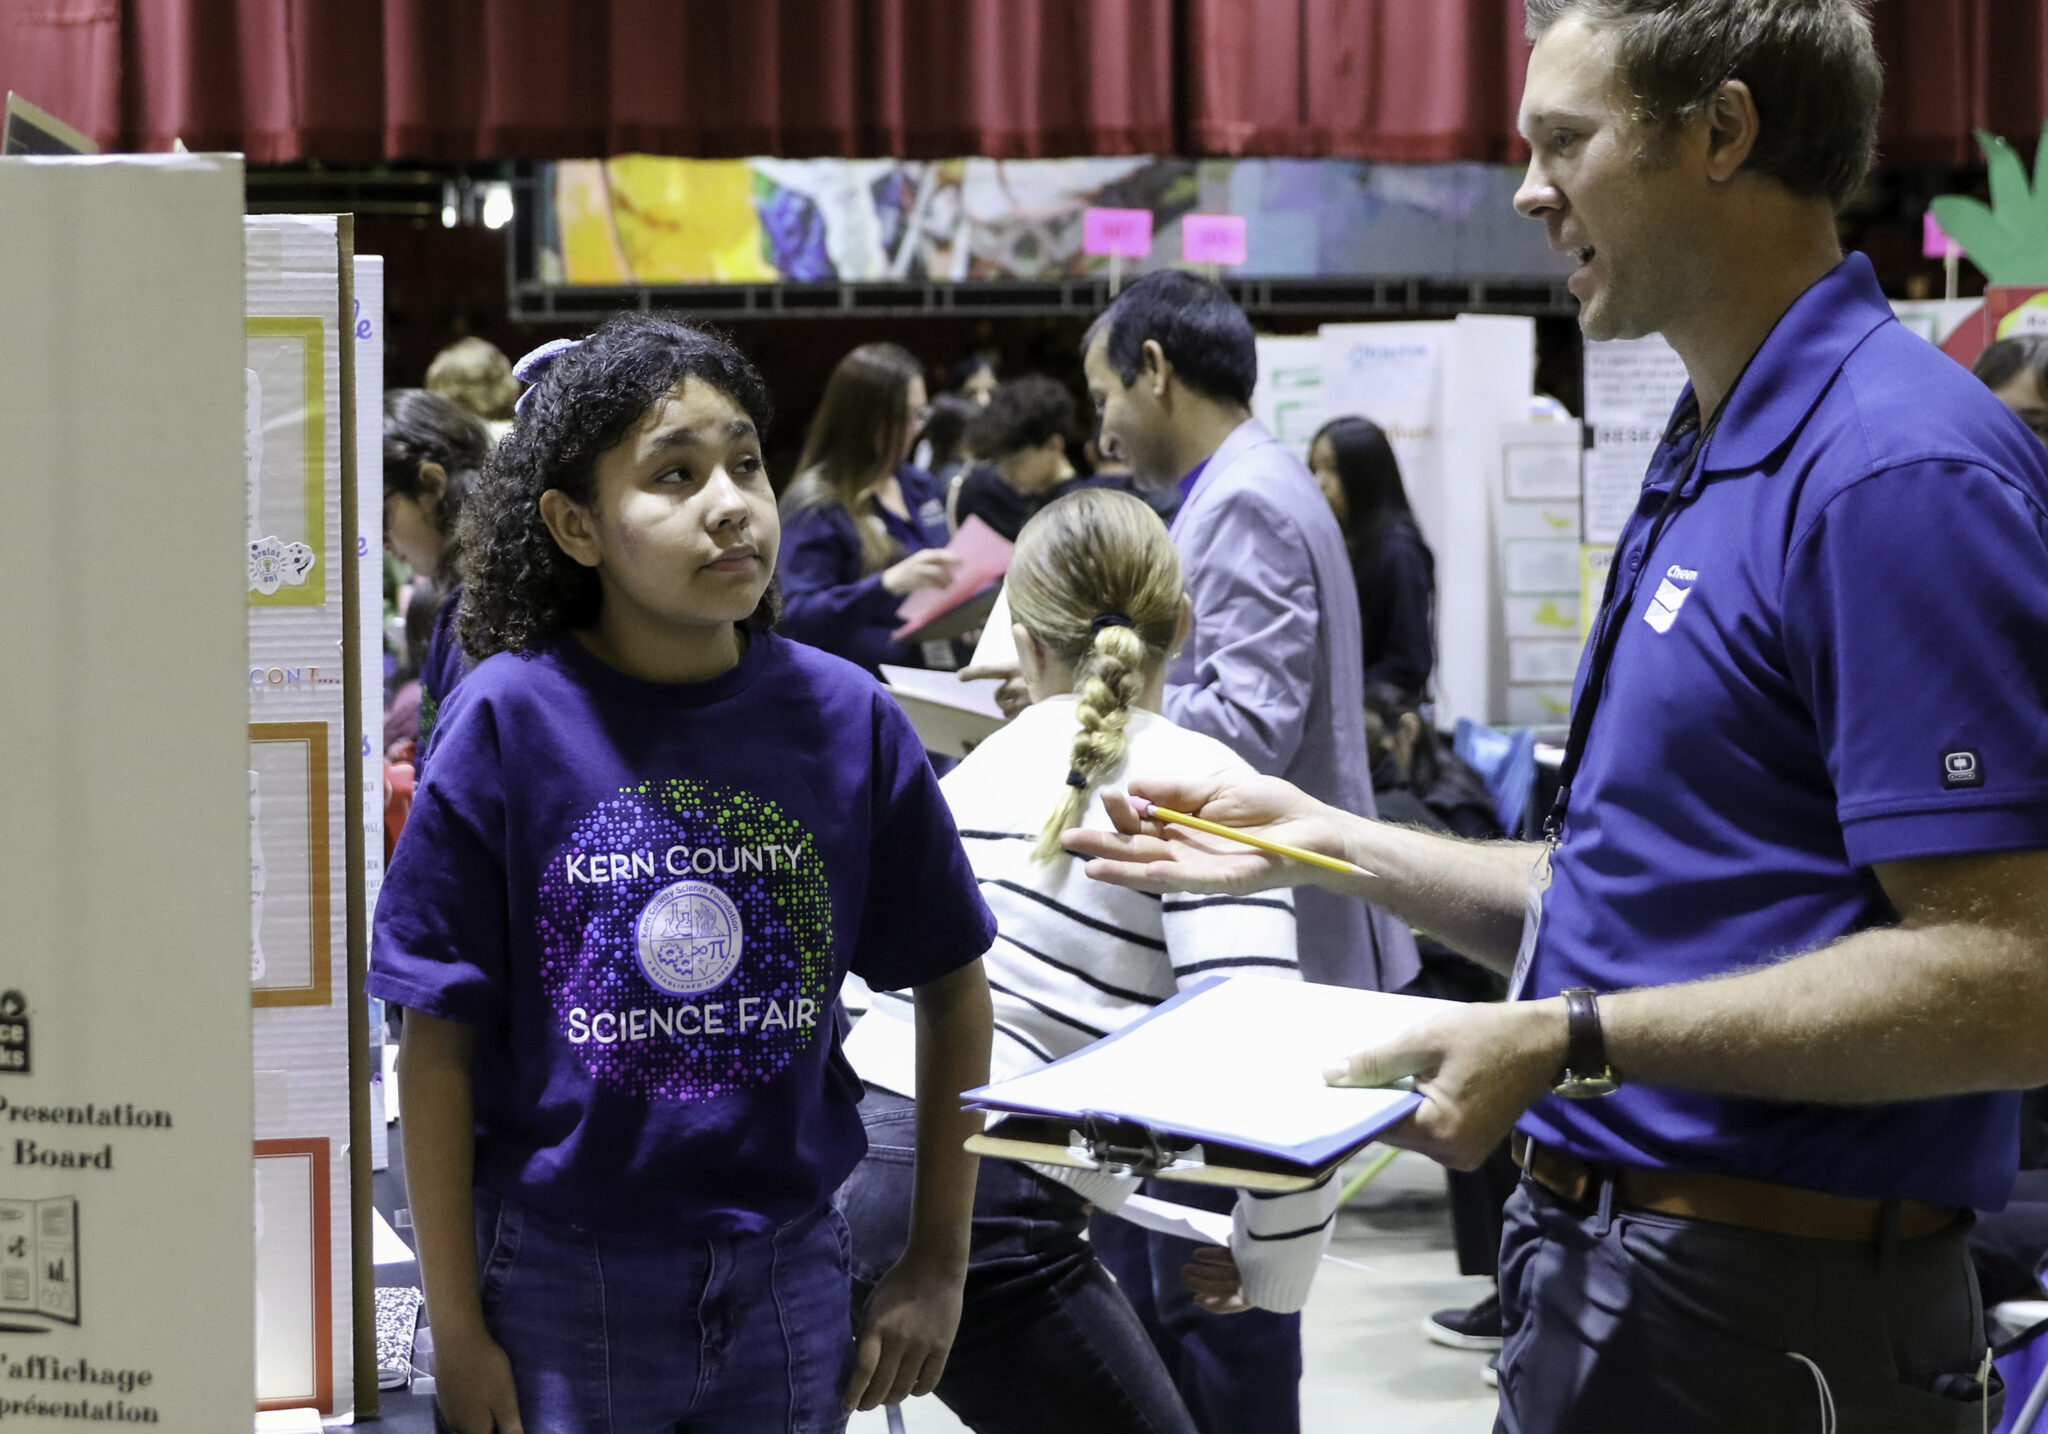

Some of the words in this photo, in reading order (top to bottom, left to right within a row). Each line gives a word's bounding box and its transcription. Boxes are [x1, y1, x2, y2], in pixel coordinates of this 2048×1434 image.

[251, 548, 281, 560] brains
[565, 851, 656, 885] KERN
[665, 844, 801, 876] COUNTY
[641, 916, 652, 938] Kern
[648, 890, 674, 915] County
[675, 884, 708, 894] Science
[710, 889, 739, 932] Foundation
[567, 1005, 725, 1043] SCIENCE
[738, 997, 817, 1032] FAIR
[13, 1139, 114, 1169] Board
